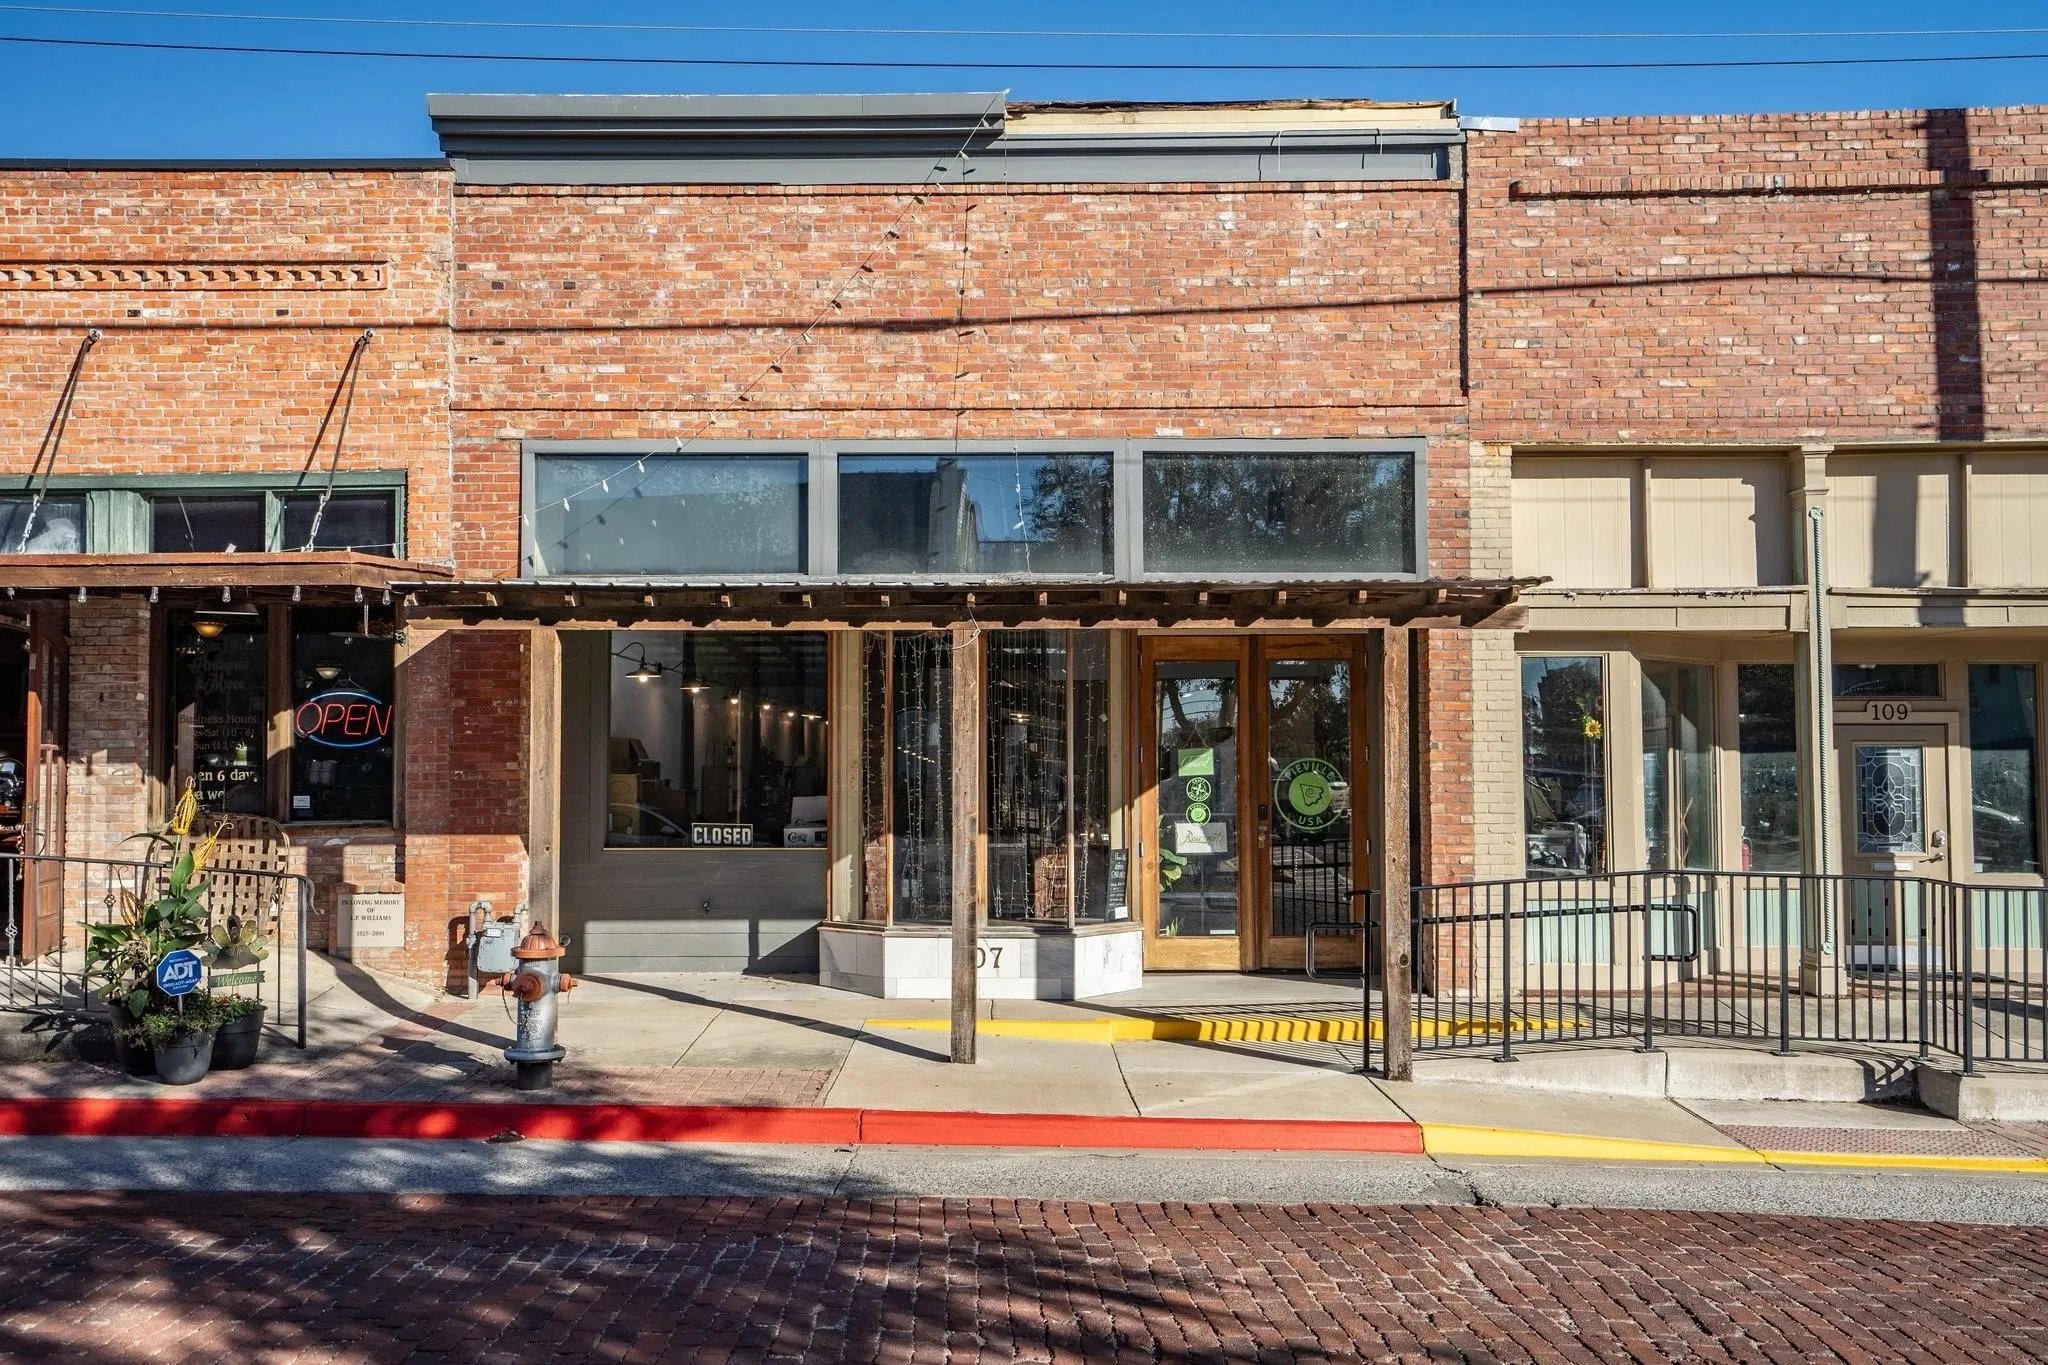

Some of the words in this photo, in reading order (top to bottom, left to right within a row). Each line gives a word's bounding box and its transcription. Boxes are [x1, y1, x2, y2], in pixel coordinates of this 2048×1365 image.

[296, 702, 393, 736] OPEN
[1871, 703, 1909, 720] 109
[217, 770, 225, 782] 6
[1284, 762, 1337, 781] PIEVILLE
[1298, 815, 1324, 826] USA
[693, 826, 752, 845] CLOSED
[162, 961, 197, 982] ADT
[216, 974, 258, 987] Welcome
